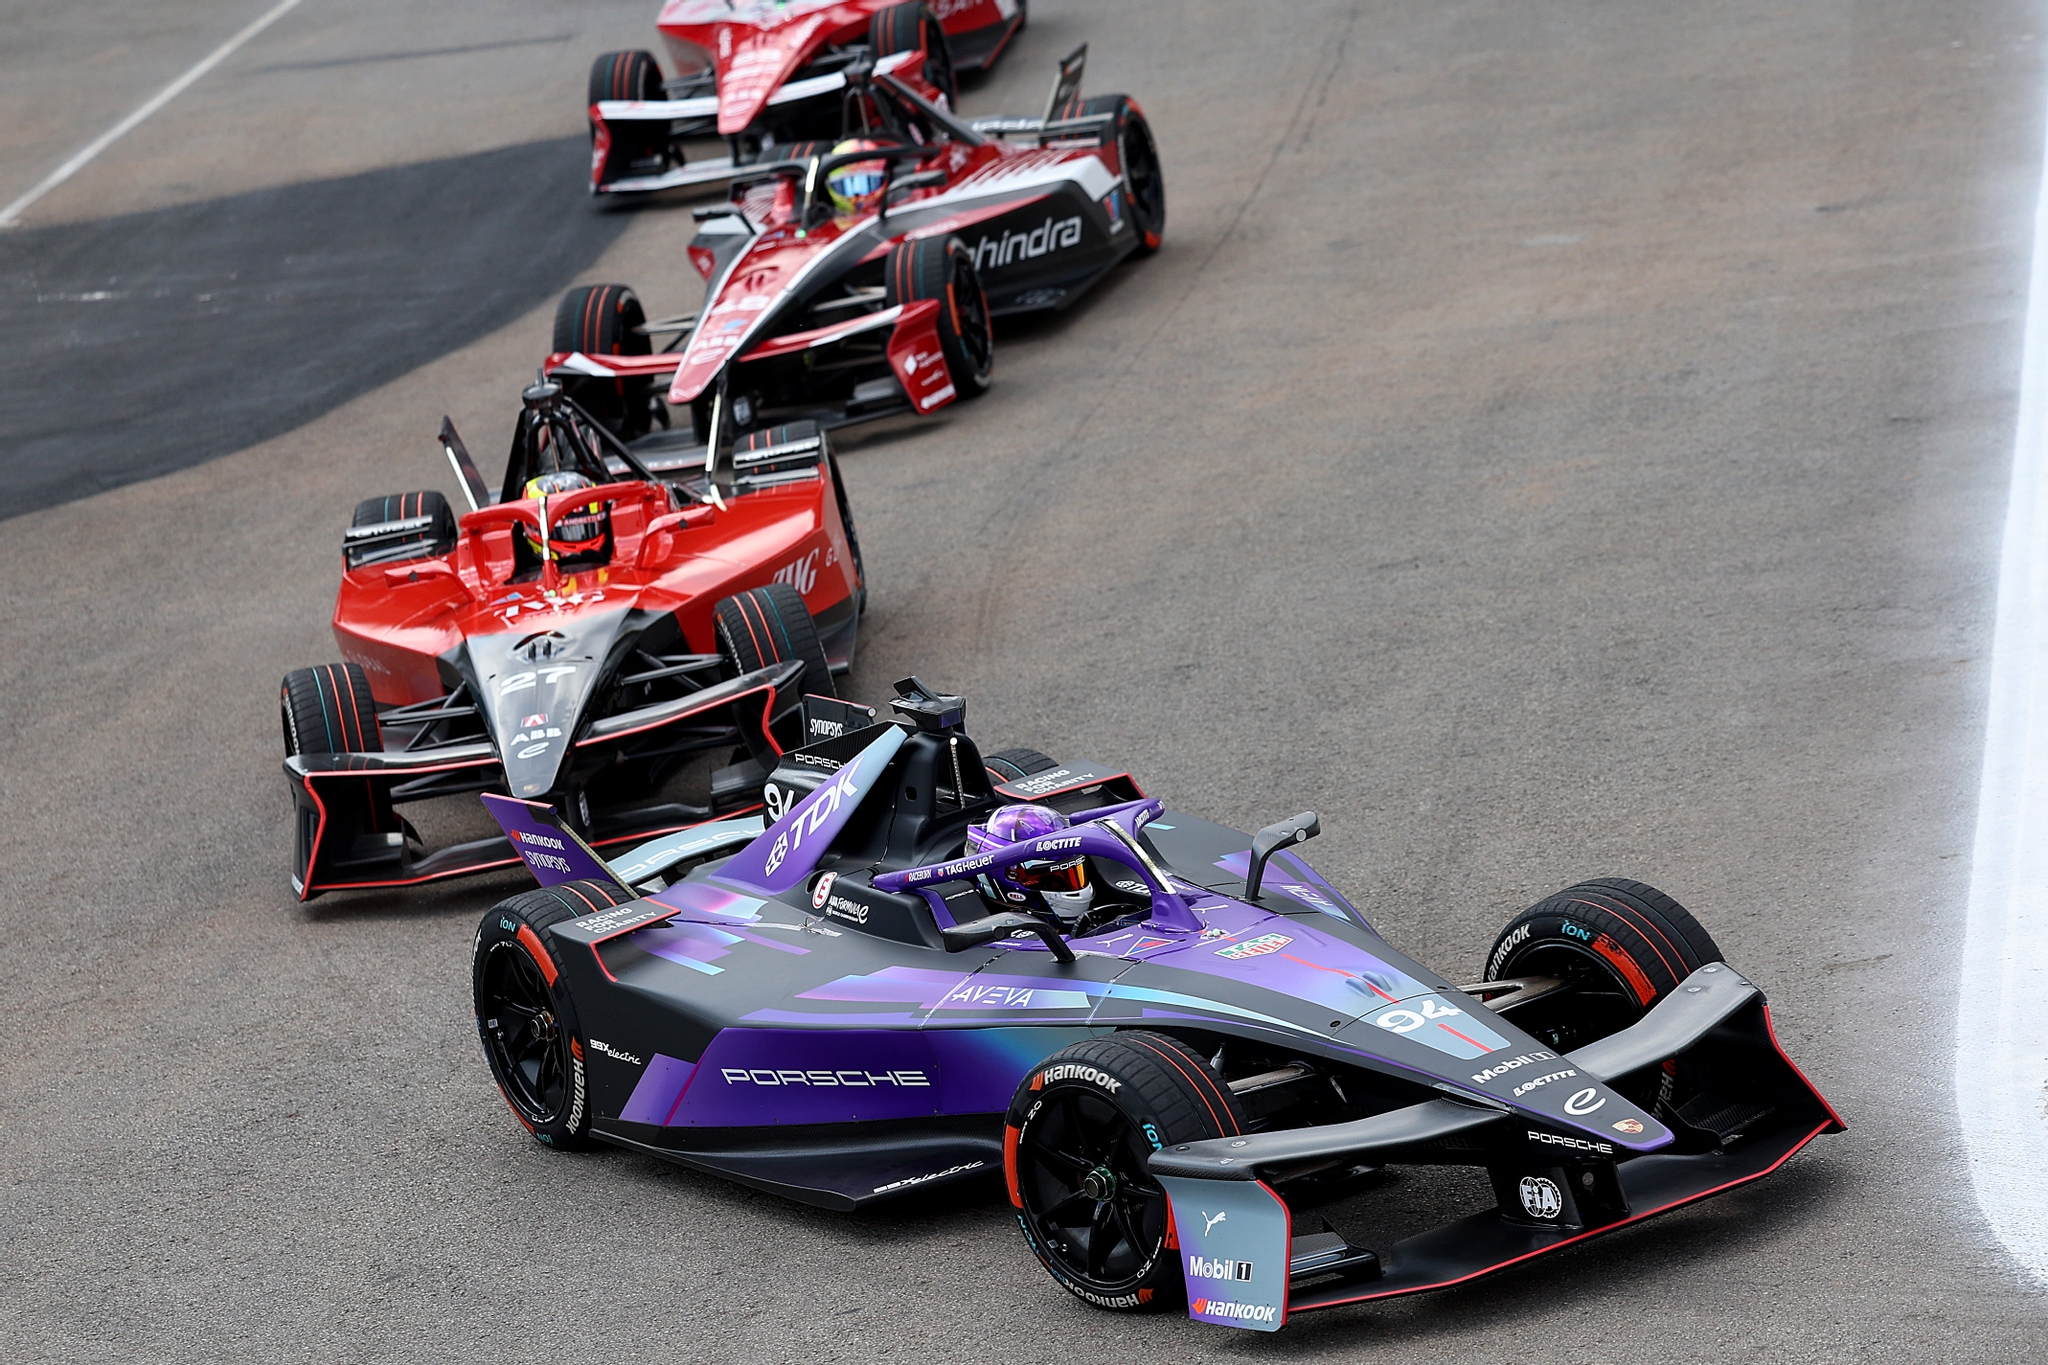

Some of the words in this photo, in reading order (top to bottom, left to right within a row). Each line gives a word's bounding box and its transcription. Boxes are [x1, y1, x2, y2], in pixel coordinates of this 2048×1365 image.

[966, 215, 1083, 272] hindra
[500, 665, 577, 697] 27
[511, 727, 562, 746] ABB
[795, 754, 849, 769] PORSCH
[1014, 769, 1071, 790] RACING
[1033, 772, 1095, 795] CHARITY
[790, 755, 865, 851] TDK
[1036, 836, 1082, 852] LOCTITE
[576, 907, 633, 929] RACING
[593, 911, 657, 934] CHARITY
[1220, 933, 1281, 956] TAG
[951, 984, 1035, 1007] AVEVA
[1376, 999, 1464, 1034] 94
[607, 1048, 642, 1065] electric
[720, 1067, 931, 1087] PORSCHE
[1471, 1055, 1534, 1085] Mobil
[1512, 1069, 1577, 1098] LOCTITE
[1528, 1130, 1613, 1154] PORSCHE
[1190, 1255, 1234, 1281] Mobil
